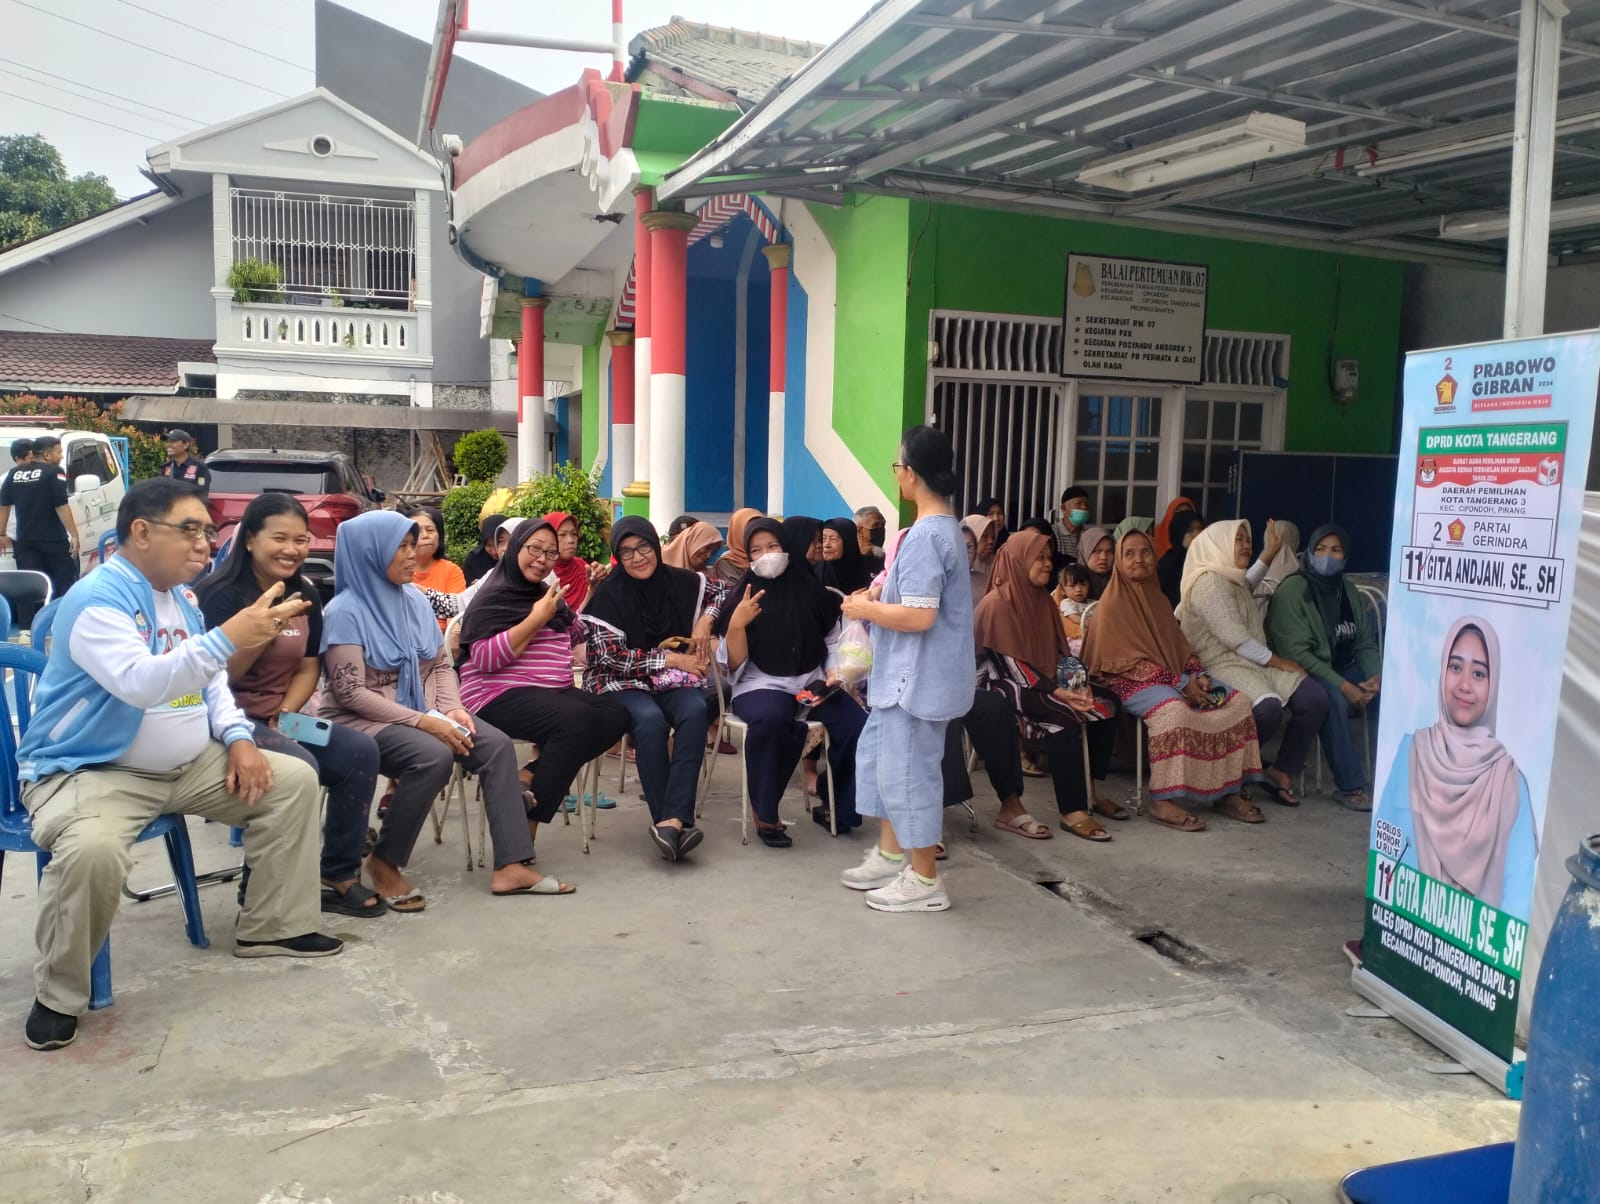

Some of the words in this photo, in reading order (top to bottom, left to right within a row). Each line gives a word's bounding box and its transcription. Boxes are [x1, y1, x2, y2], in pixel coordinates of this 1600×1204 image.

[1101, 263, 1128, 280] BALAI
[1129, 265, 1179, 286] PERTEMUAN
[1085, 316, 1130, 325] SEKRETARIAT
[1084, 327, 1116, 336] KEGIATAN
[1119, 329, 1132, 337] PKK
[1084, 339, 1116, 347] KEGIATAN
[1119, 340, 1152, 350] POSYANDU
[1083, 350, 1128, 359] SEKRETARIAT
[1142, 353, 1171, 363] PERMATA
[1444, 357, 1453, 370] 2
[1083, 361, 1101, 369] OLAH
[1104, 361, 1122, 370] RAGA
[1473, 357, 1556, 379] PRABOWO
[1472, 377, 1534, 396] GIBRAN
[1426, 435, 1453, 449] DPRD
[1454, 433, 1484, 448] KOTA
[1486, 431, 1557, 447] TANGERANG
[1441, 496, 1464, 504] KOTA
[1465, 497, 1518, 505] TANGERANG
[1520, 498, 1526, 506] 3
[1458, 506, 1496, 514] CIPONDOH,
[1497, 507, 1526, 515] PINANG
[1433, 521, 1442, 541] 2
[1473, 521, 1511, 534] PARTAI
[1472, 535, 1528, 550] GERINDRA
[1405, 550, 1423, 581] 11
[1427, 555, 1452, 582] GITA
[1454, 558, 1506, 590] ANDJANI,
[1536, 564, 1557, 594] SH
[1376, 819, 1402, 838] COBLOS
[1376, 830, 1400, 848] NOMOR
[1376, 841, 1399, 858] URUT
[1378, 860, 1393, 901] 11
[1396, 865, 1421, 916] GITA
[1421, 879, 1474, 950] ANDJANI,
[1503, 919, 1526, 971] SH
[1372, 903, 1394, 930] CALEG
[1394, 916, 1413, 941] DPRD
[1414, 925, 1433, 951] KOTA
[1434, 935, 1481, 979] TANGERANG
[1482, 966, 1506, 994] DAPIL
[1508, 981, 1515, 1000] 3
[1381, 929, 1423, 966] KECAMATAN
[1423, 955, 1464, 997] CIPONDOH,
[1465, 981, 1496, 1011] PINANG
